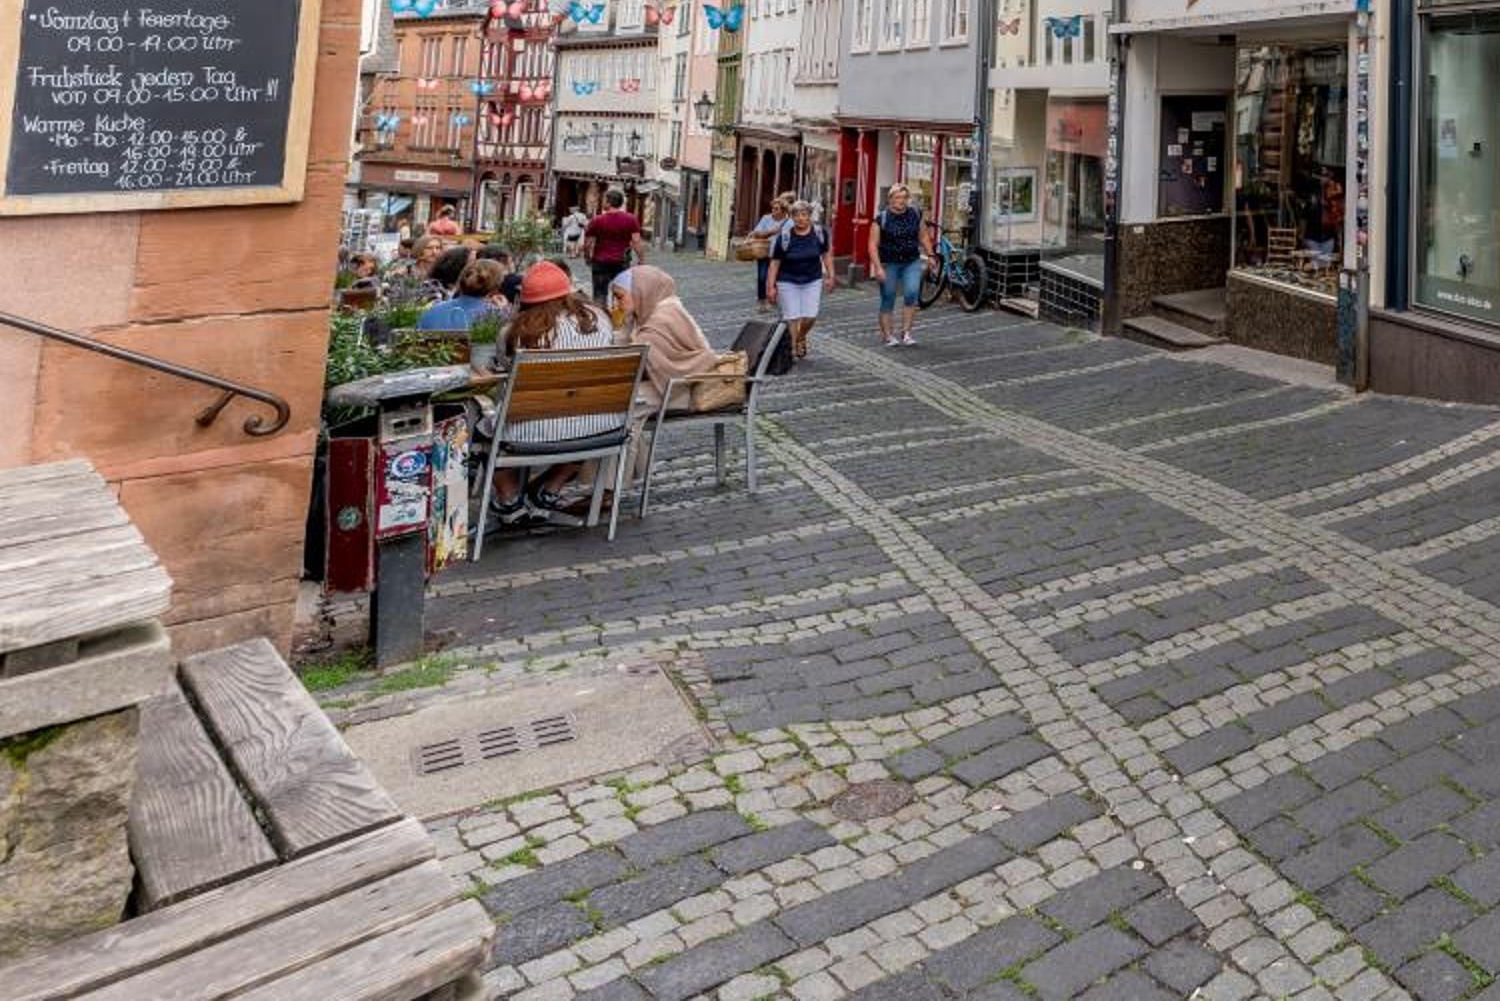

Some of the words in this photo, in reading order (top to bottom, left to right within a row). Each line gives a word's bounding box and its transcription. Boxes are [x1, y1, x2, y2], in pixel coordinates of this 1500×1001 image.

[40, 7, 119, 33] Sonntag
[202, 36, 241, 51] Uhr
[131, 66, 193, 90] jeden
[202, 66, 236, 91] Tag
[50, 89, 87, 105] von
[23, 116, 85, 133] Warme
[50, 158, 109, 178] Freitag
